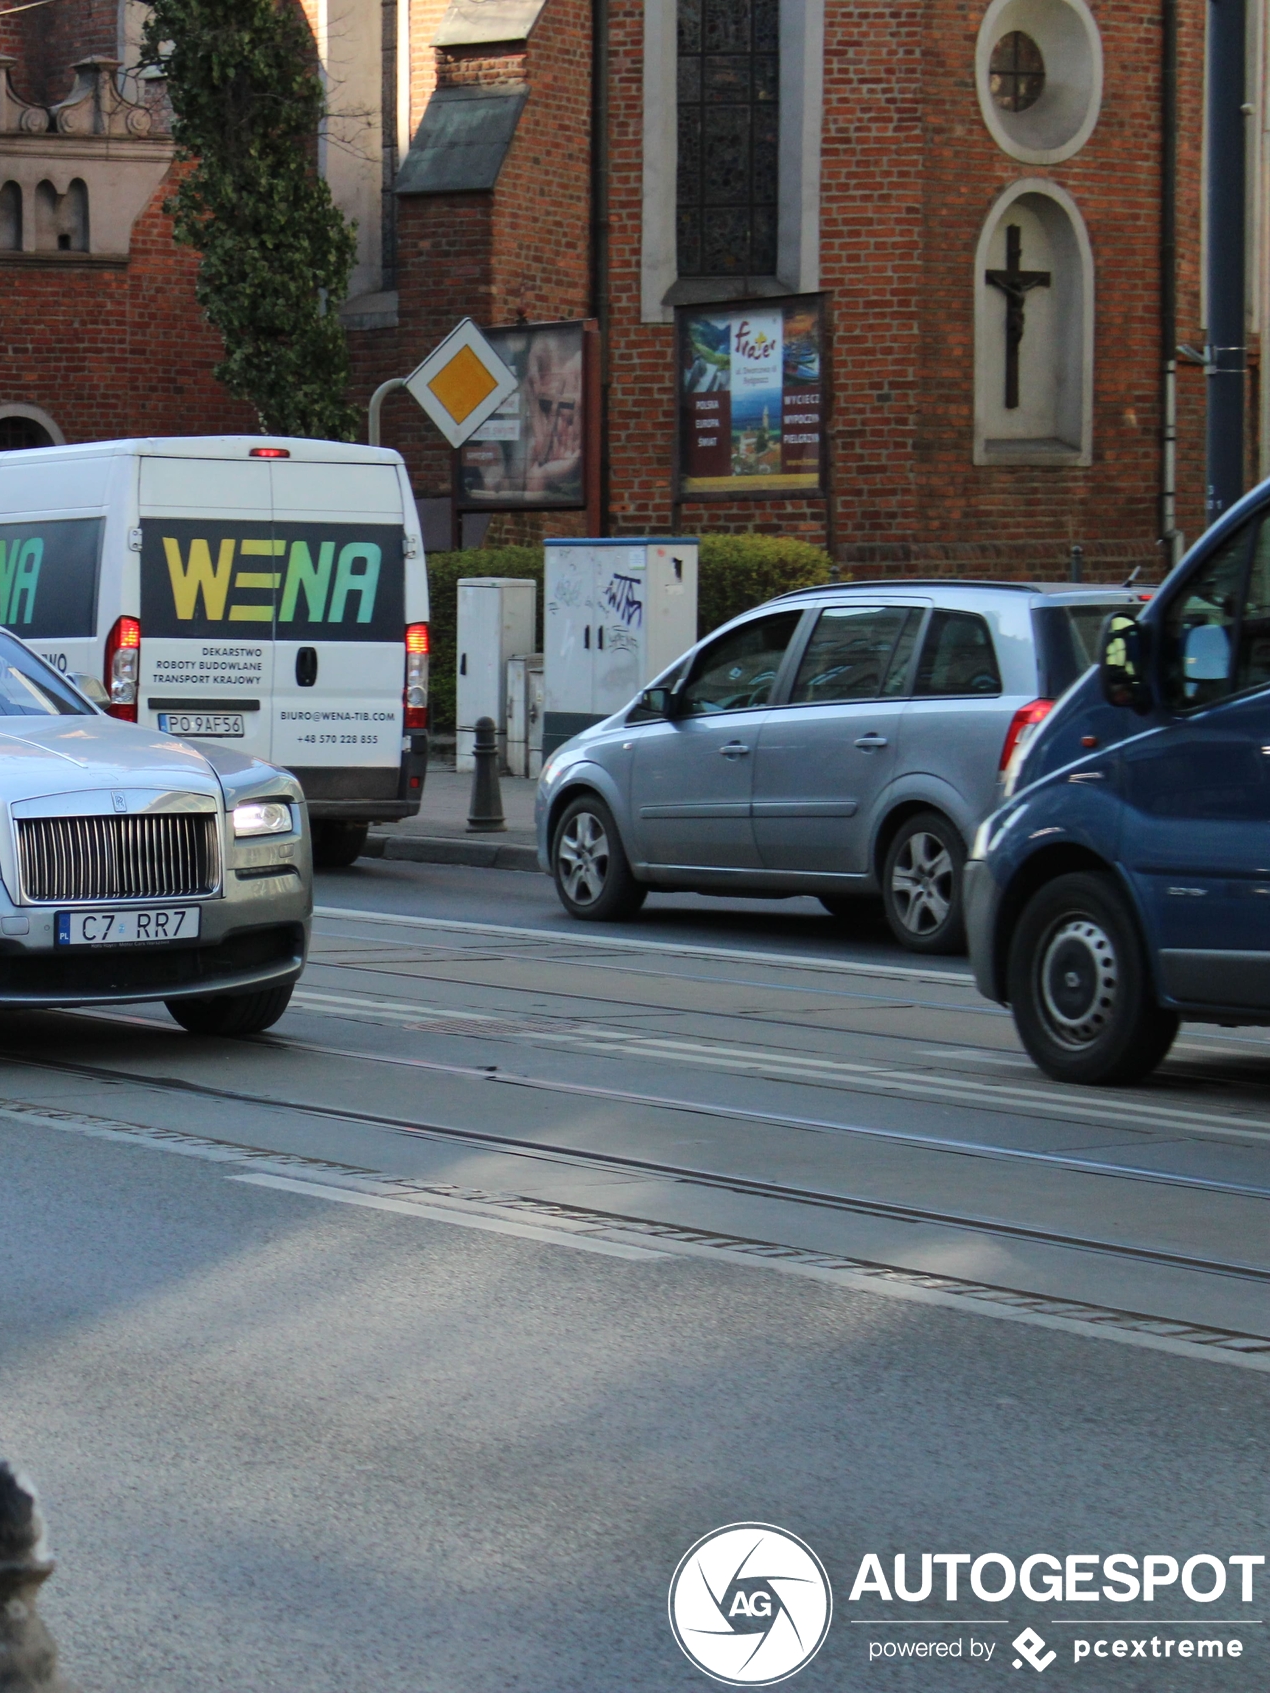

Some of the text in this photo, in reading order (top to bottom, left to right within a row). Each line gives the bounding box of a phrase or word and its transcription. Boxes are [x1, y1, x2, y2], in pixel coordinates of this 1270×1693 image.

[162, 537, 382, 623] WENA
[203, 648, 262, 656] DEKARSTWO
[157, 661, 262, 670] ROBOTY BUDOWLANE
[153, 675, 261, 684] TRANSPORT KRAJOWY
[281, 711, 395, 722] BIURO@WENA-TIB.COM
[169, 717, 240, 732] PO 9AF56
[297, 735, 378, 743] +48 570 228 855
[83, 911, 186, 941] C7 RR7
